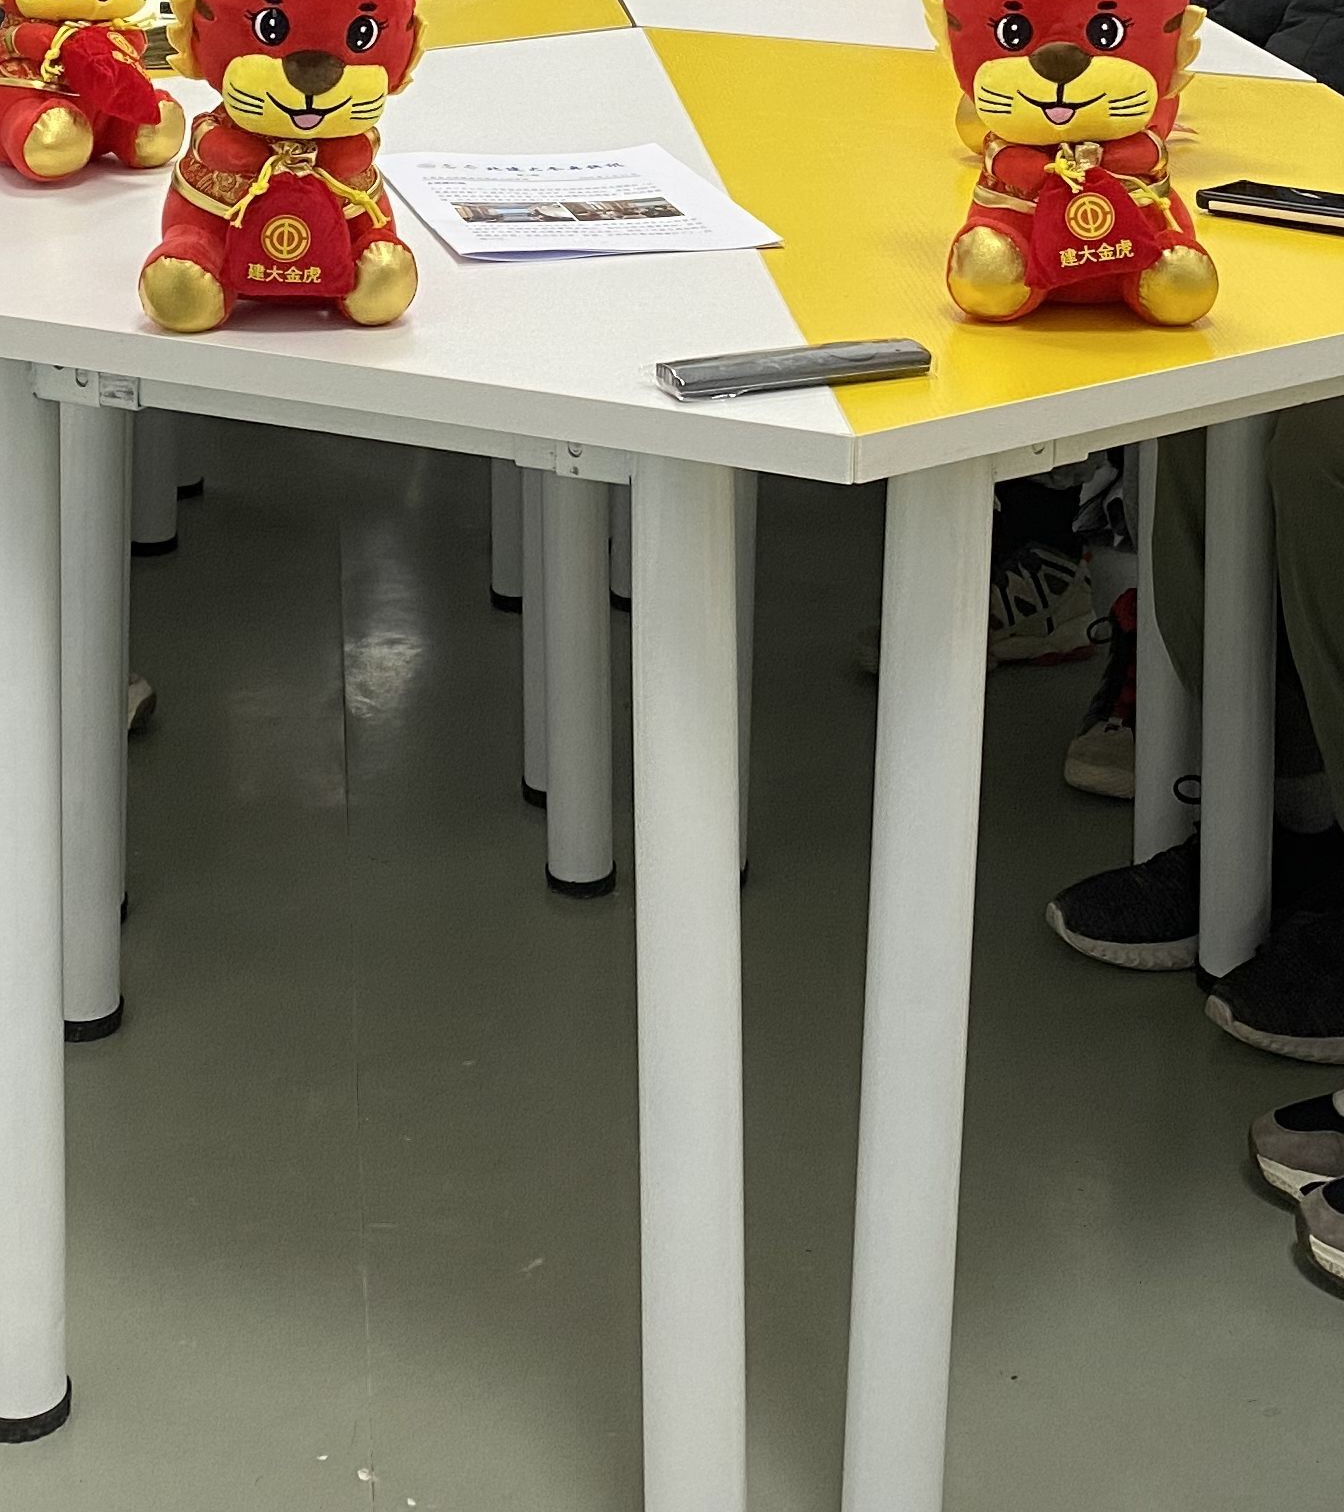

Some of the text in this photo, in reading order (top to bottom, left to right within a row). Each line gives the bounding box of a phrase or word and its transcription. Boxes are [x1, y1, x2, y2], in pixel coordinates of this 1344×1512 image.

[1059, 239, 1135, 268] 建大金虎
[247, 263, 322, 284] 建大金虎
